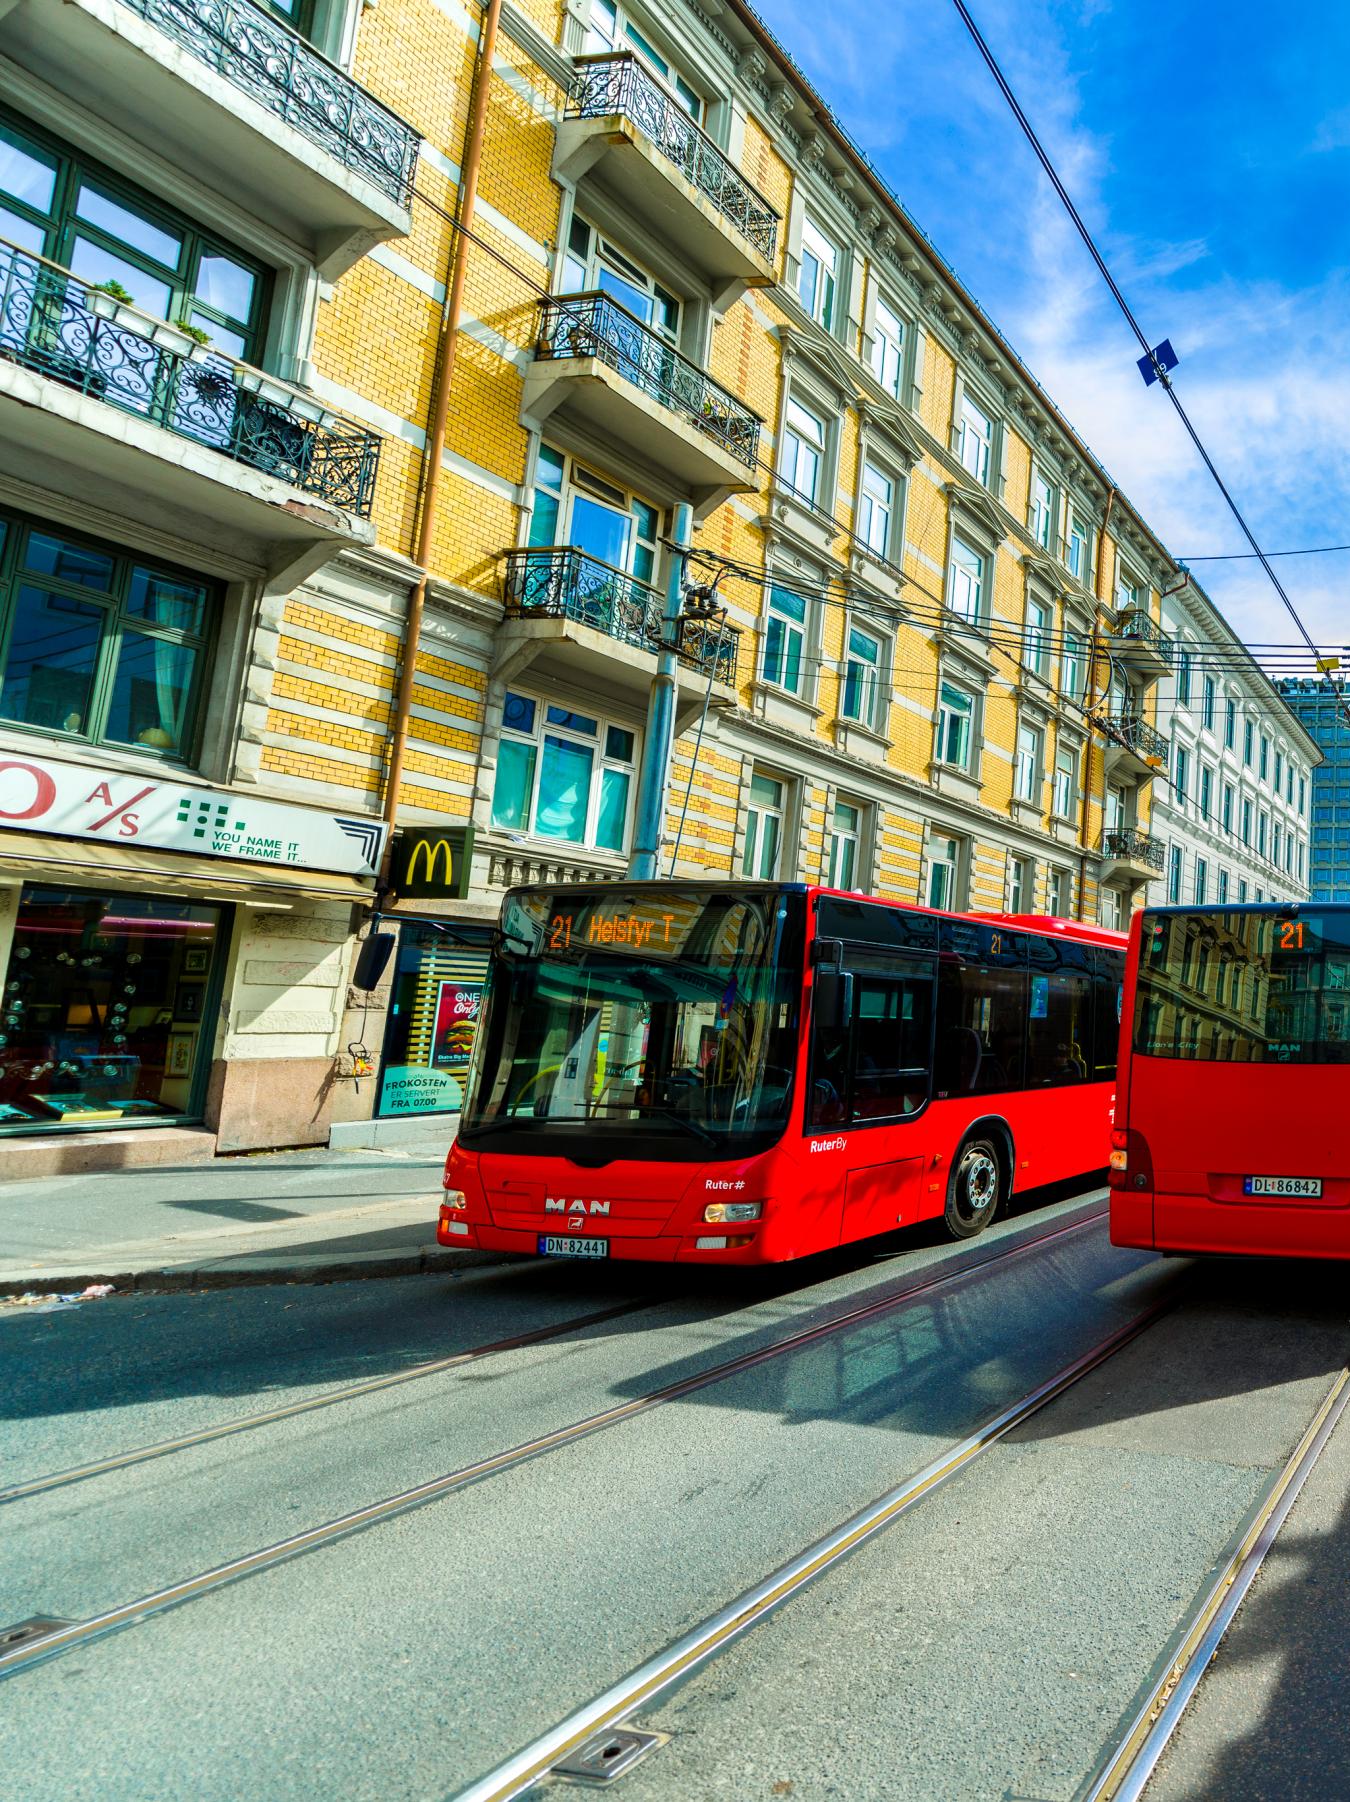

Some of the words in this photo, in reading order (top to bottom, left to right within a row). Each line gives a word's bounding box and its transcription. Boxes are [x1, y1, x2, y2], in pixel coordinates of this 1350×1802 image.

[214, 831, 241, 844] YOU
[246, 836, 282, 850] NAME
[288, 842, 299, 851] IT
[212, 841, 232, 852] WE
[238, 845, 282, 858] FRAME
[550, 915, 573, 948] 21
[589, 914, 655, 948] Helsfyr
[662, 916, 674, 943] T
[1281, 922, 1303, 949] 21
[991, 934, 1001, 954] 21
[455, 993, 480, 1002] ONE
[454, 1002, 480, 1019] Only
[1268, 1044, 1300, 1052] MAN
[385, 1079, 447, 1091] FROKOSTEN
[390, 1091, 401, 1099] ER
[404, 1089, 440, 1098] SERVERT
[391, 1100, 410, 1108] FRA
[413, 1098, 437, 1107] 07.00
[810, 1137, 847, 1153] RuterBy
[705, 1179, 745, 1190] Ruter#
[1254, 1179, 1269, 1192] DL
[1277, 1180, 1318, 1194] 86842
[545, 1198, 611, 1216] MAN
[548, 1239, 563, 1253] DN
[569, 1240, 605, 1256] 82441
